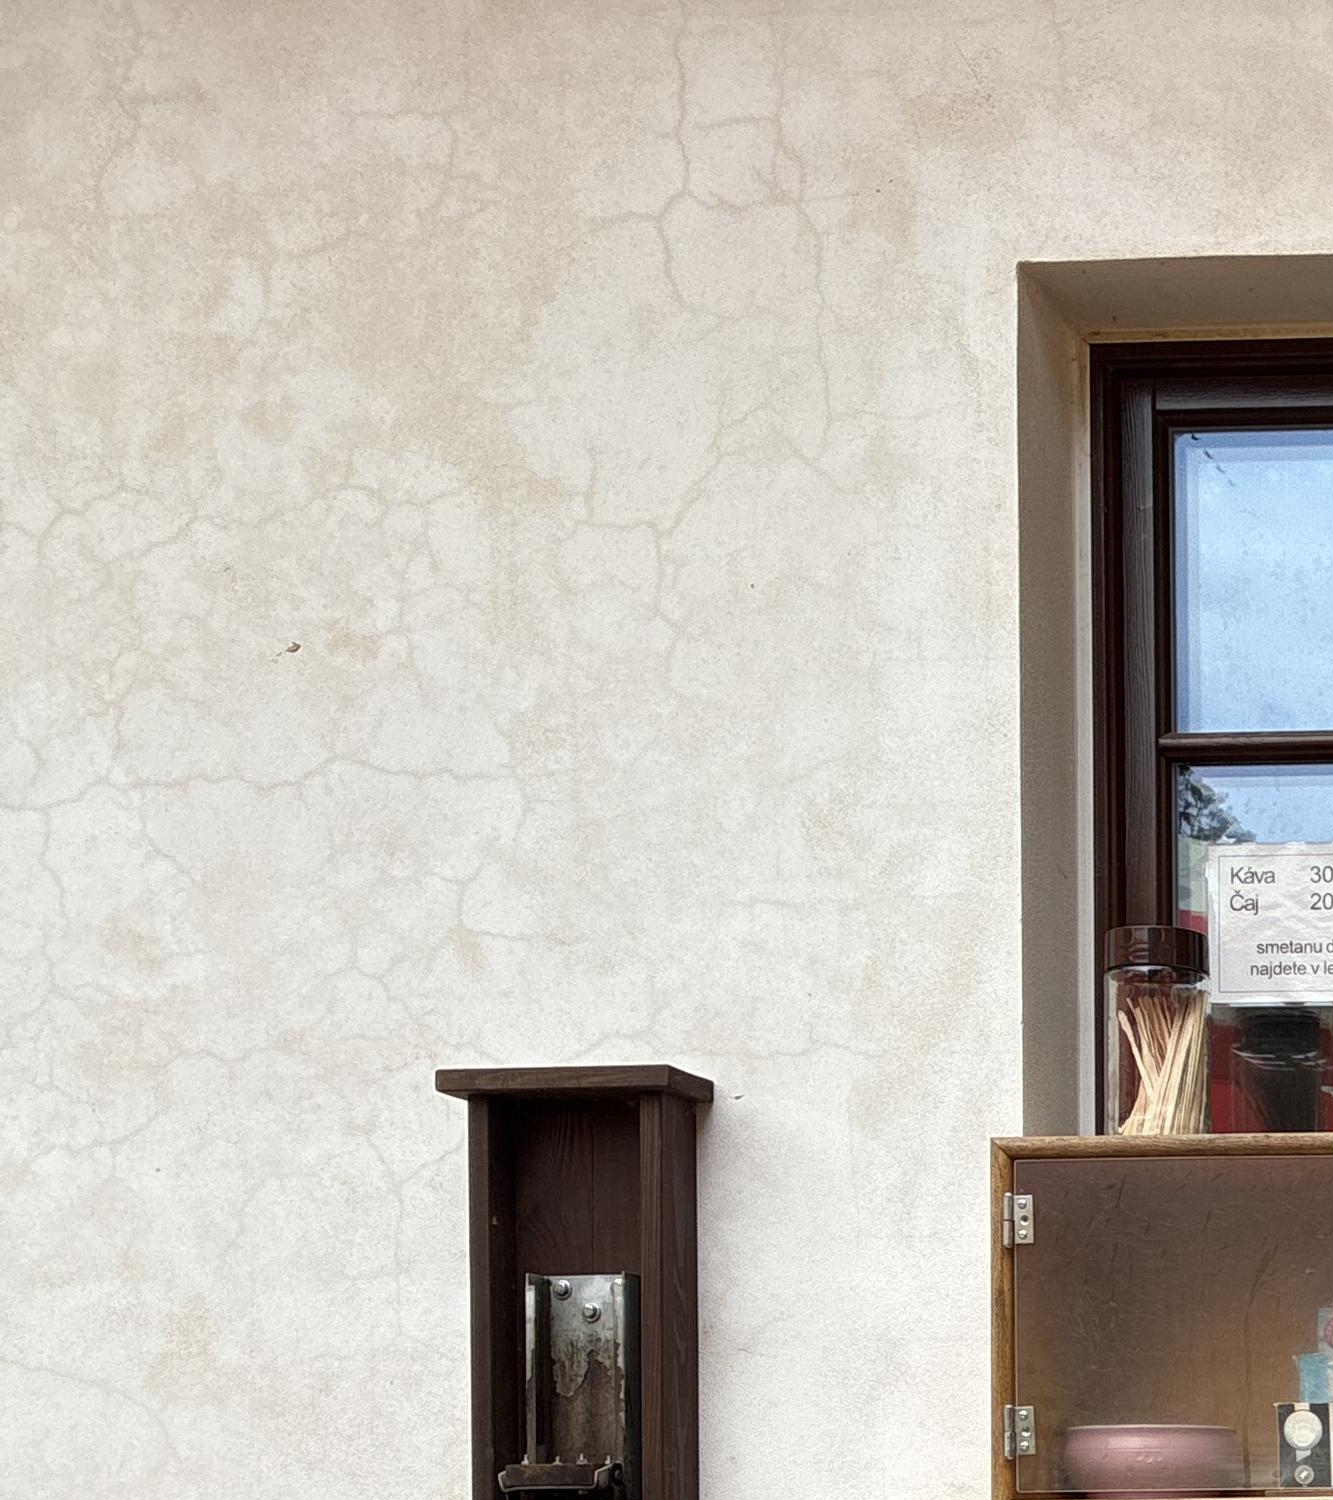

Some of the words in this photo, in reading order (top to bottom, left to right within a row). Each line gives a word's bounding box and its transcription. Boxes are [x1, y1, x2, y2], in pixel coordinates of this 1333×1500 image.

[1230, 867, 1276, 884] Káva
[1229, 890, 1259, 915] Čaj
[1256, 940, 1323, 954] smetanu
[1250, 962, 1306, 980] najdete
[1310, 965, 1319, 975] v
